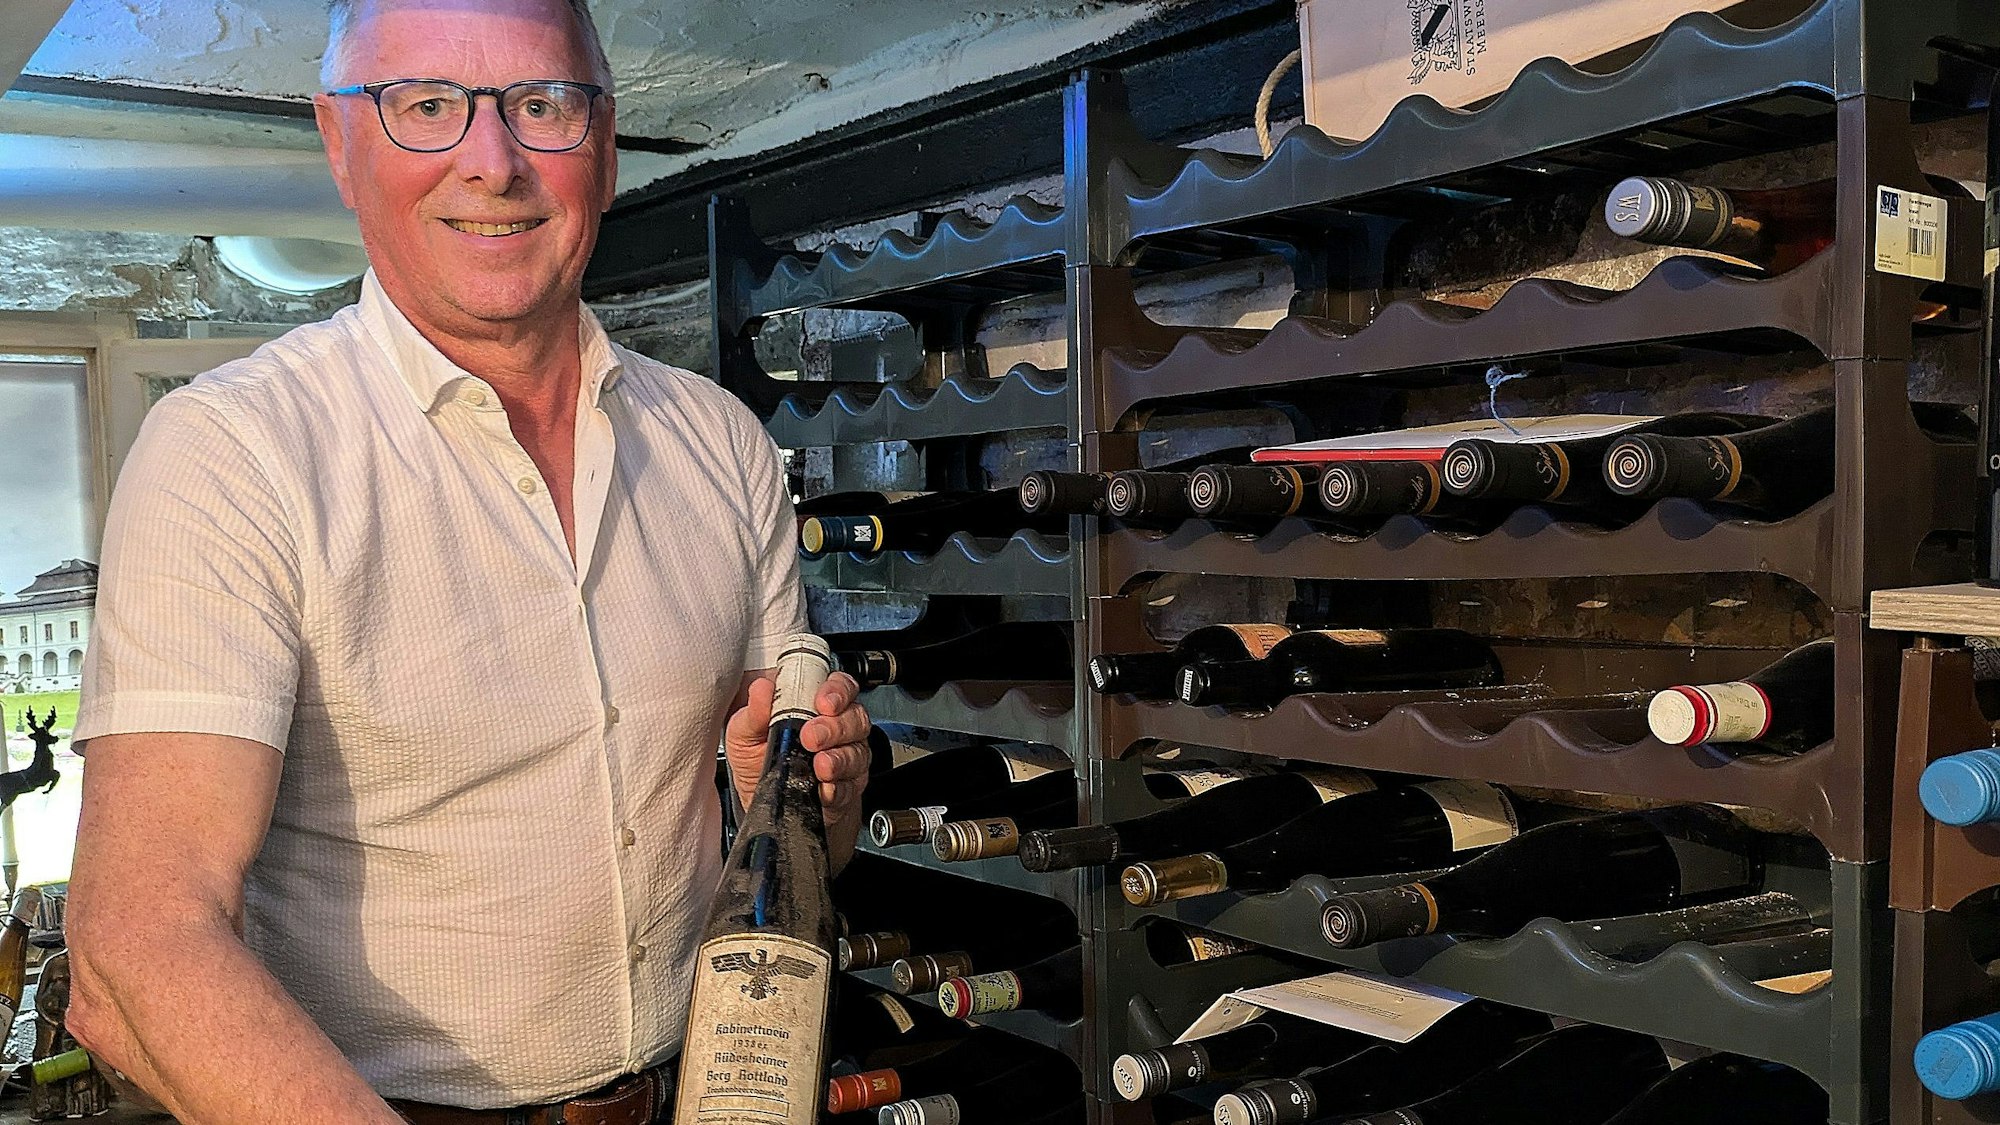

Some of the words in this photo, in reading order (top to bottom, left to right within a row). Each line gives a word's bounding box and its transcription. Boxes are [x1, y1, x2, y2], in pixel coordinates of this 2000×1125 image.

[715, 1023, 790, 1039] Kabinettwein
[714, 1052, 788, 1068] Rüdesheimer
[706, 1070, 731, 1083] Berg
[739, 1069, 788, 1087] Rottland
